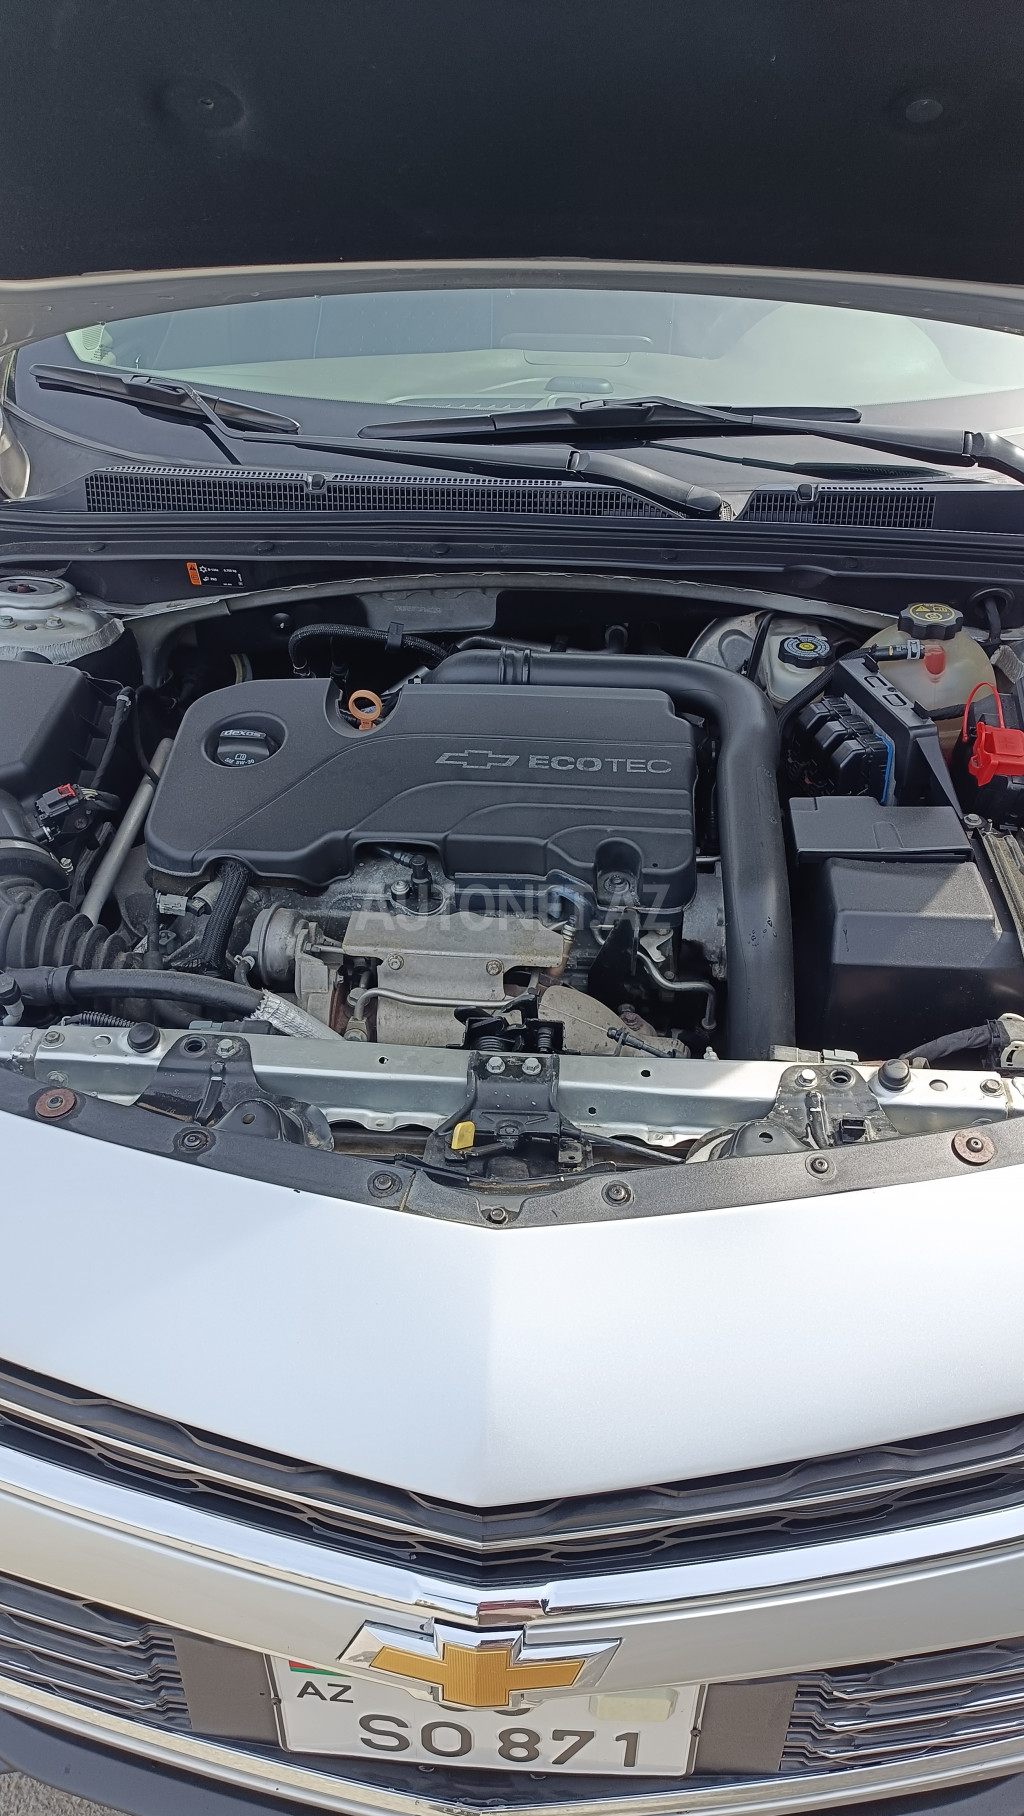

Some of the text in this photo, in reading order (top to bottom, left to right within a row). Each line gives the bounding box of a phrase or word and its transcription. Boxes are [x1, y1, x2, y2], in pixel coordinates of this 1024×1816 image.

[528, 754, 672, 774] ECOTEC
[296, 1680, 354, 1704] AZ
[358, 1713, 640, 1768] SO 871
